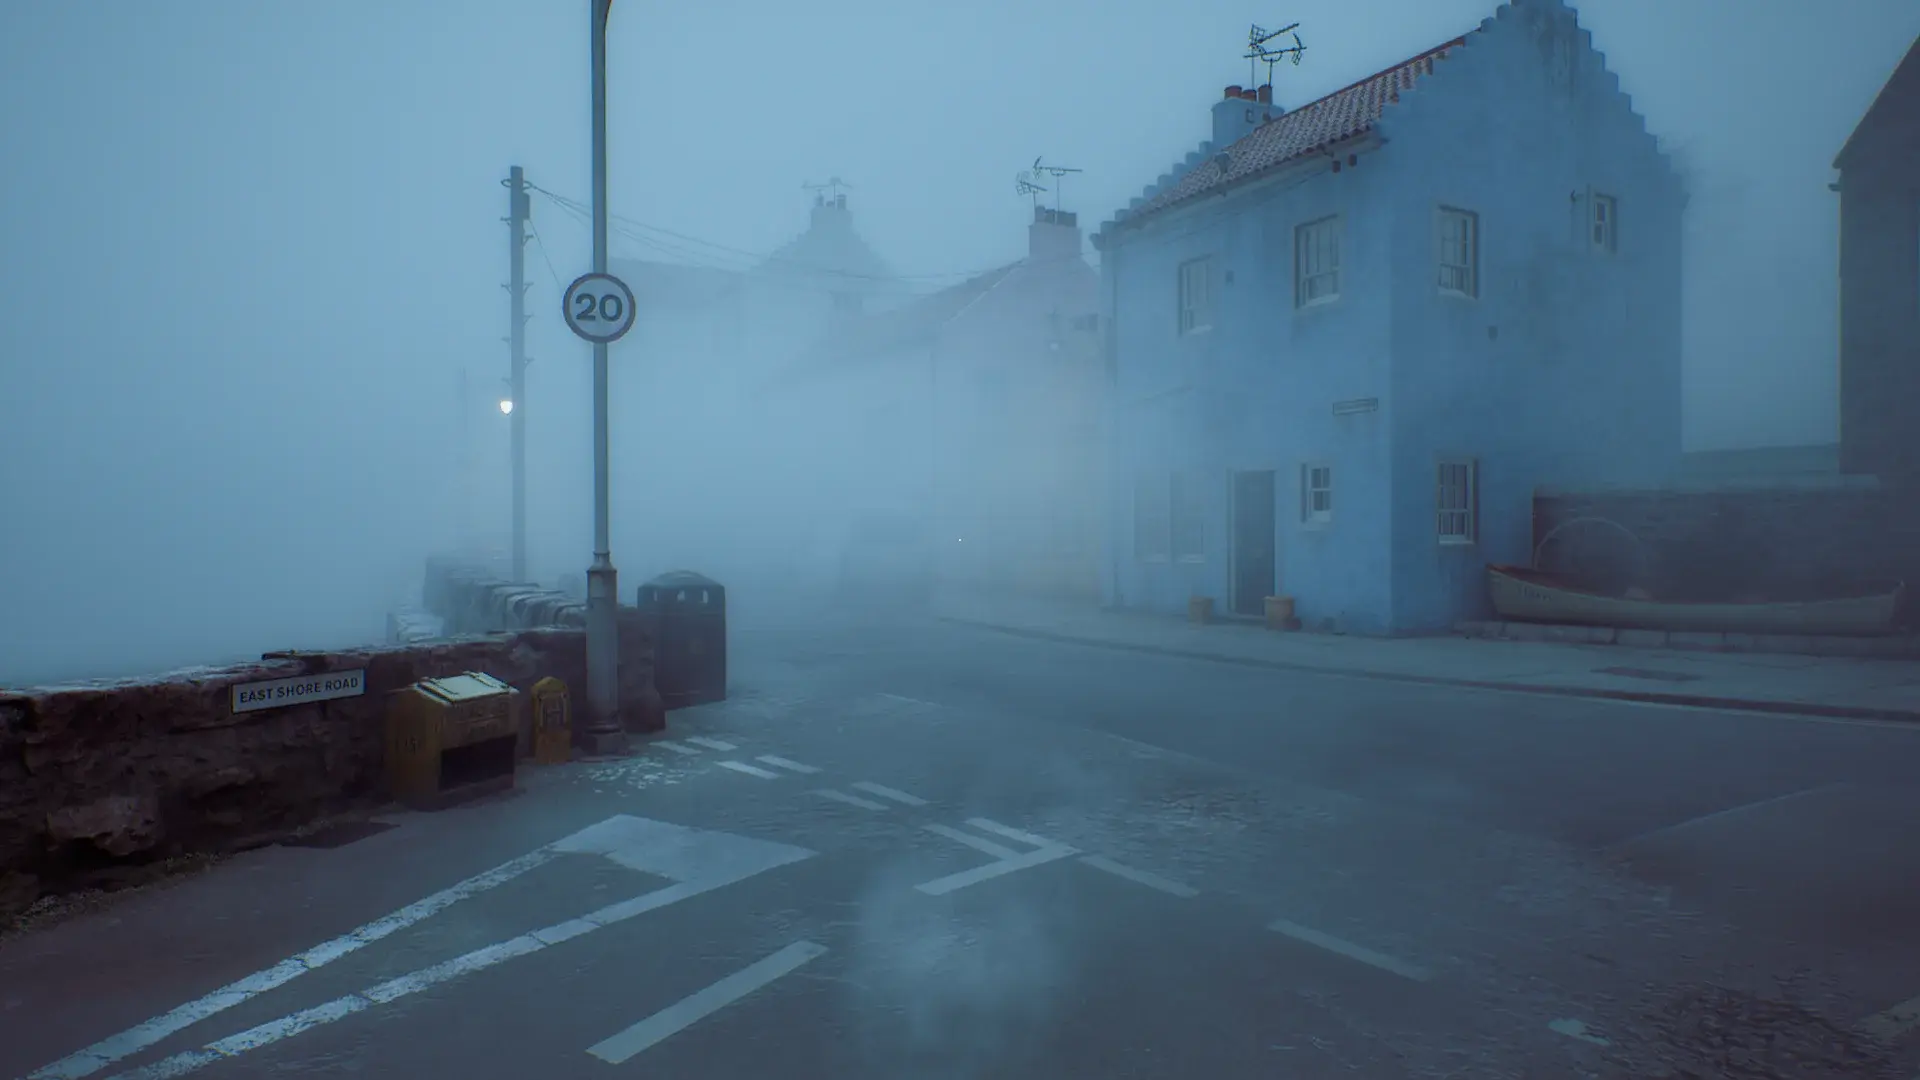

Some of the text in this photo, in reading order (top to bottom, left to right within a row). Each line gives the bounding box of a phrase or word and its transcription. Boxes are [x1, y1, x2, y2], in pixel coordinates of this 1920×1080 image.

[575, 293, 623, 322] 20
[239, 677, 358, 703] EAST SHORE ROAD
